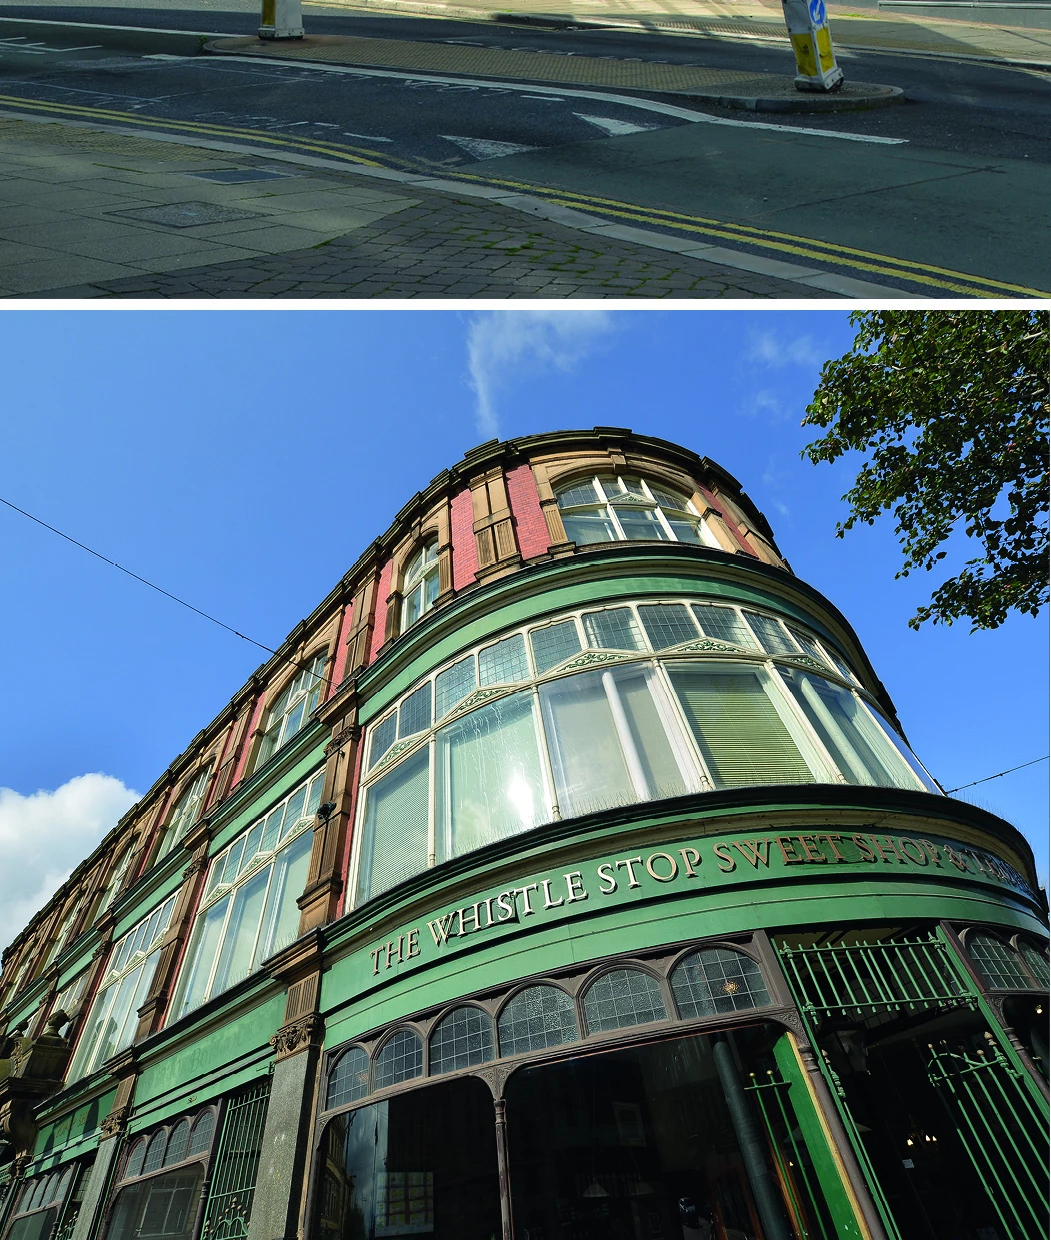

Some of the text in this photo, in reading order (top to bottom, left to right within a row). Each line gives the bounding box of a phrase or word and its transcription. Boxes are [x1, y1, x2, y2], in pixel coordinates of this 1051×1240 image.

[369, 928, 421, 976] THE
[426, 871, 588, 947] WHISTLE
[597, 847, 702, 894] STOP
[712, 834, 845, 873] SWEET
[851, 833, 945, 869] SHOP
[943, 843, 970, 872] &
